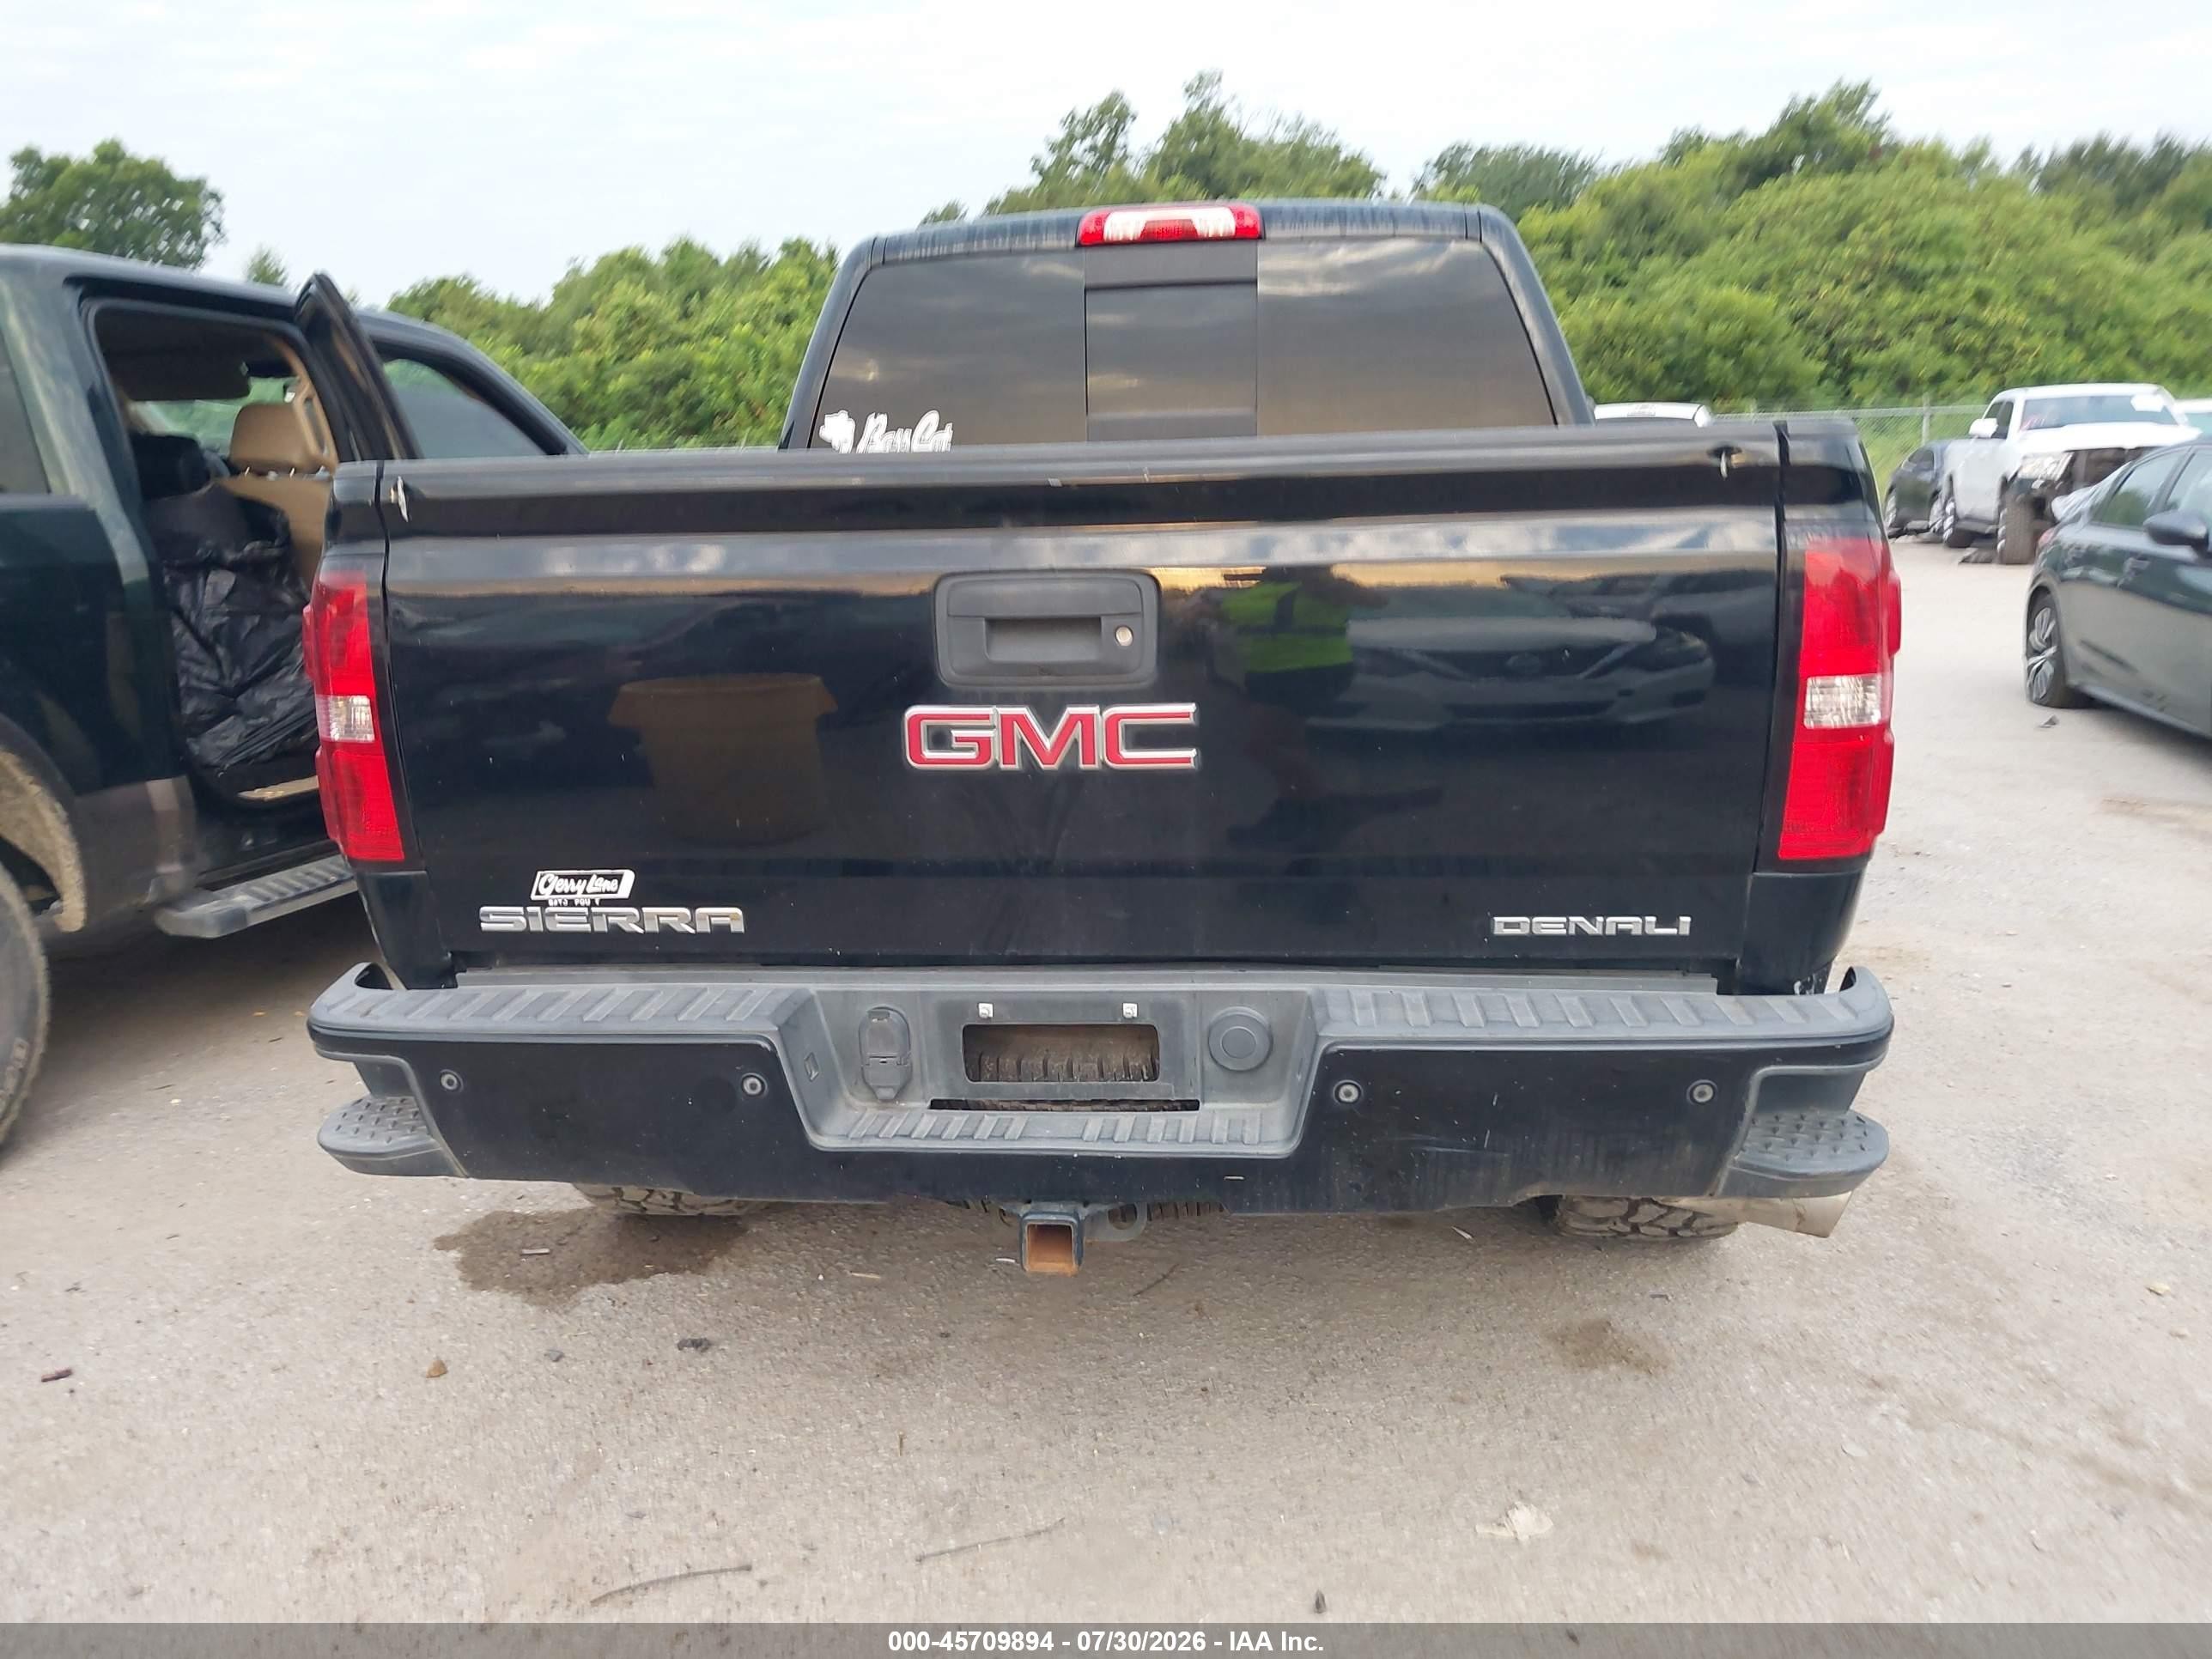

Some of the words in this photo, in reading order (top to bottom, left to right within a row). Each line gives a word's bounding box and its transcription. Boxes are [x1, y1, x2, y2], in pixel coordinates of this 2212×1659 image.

[904, 702, 1198, 770] GMC
[538, 873, 587, 896] Gerry
[586, 873, 619, 894] Lane
[479, 906, 745, 934] SIERRA
[1492, 915, 1692, 936] DENALI
